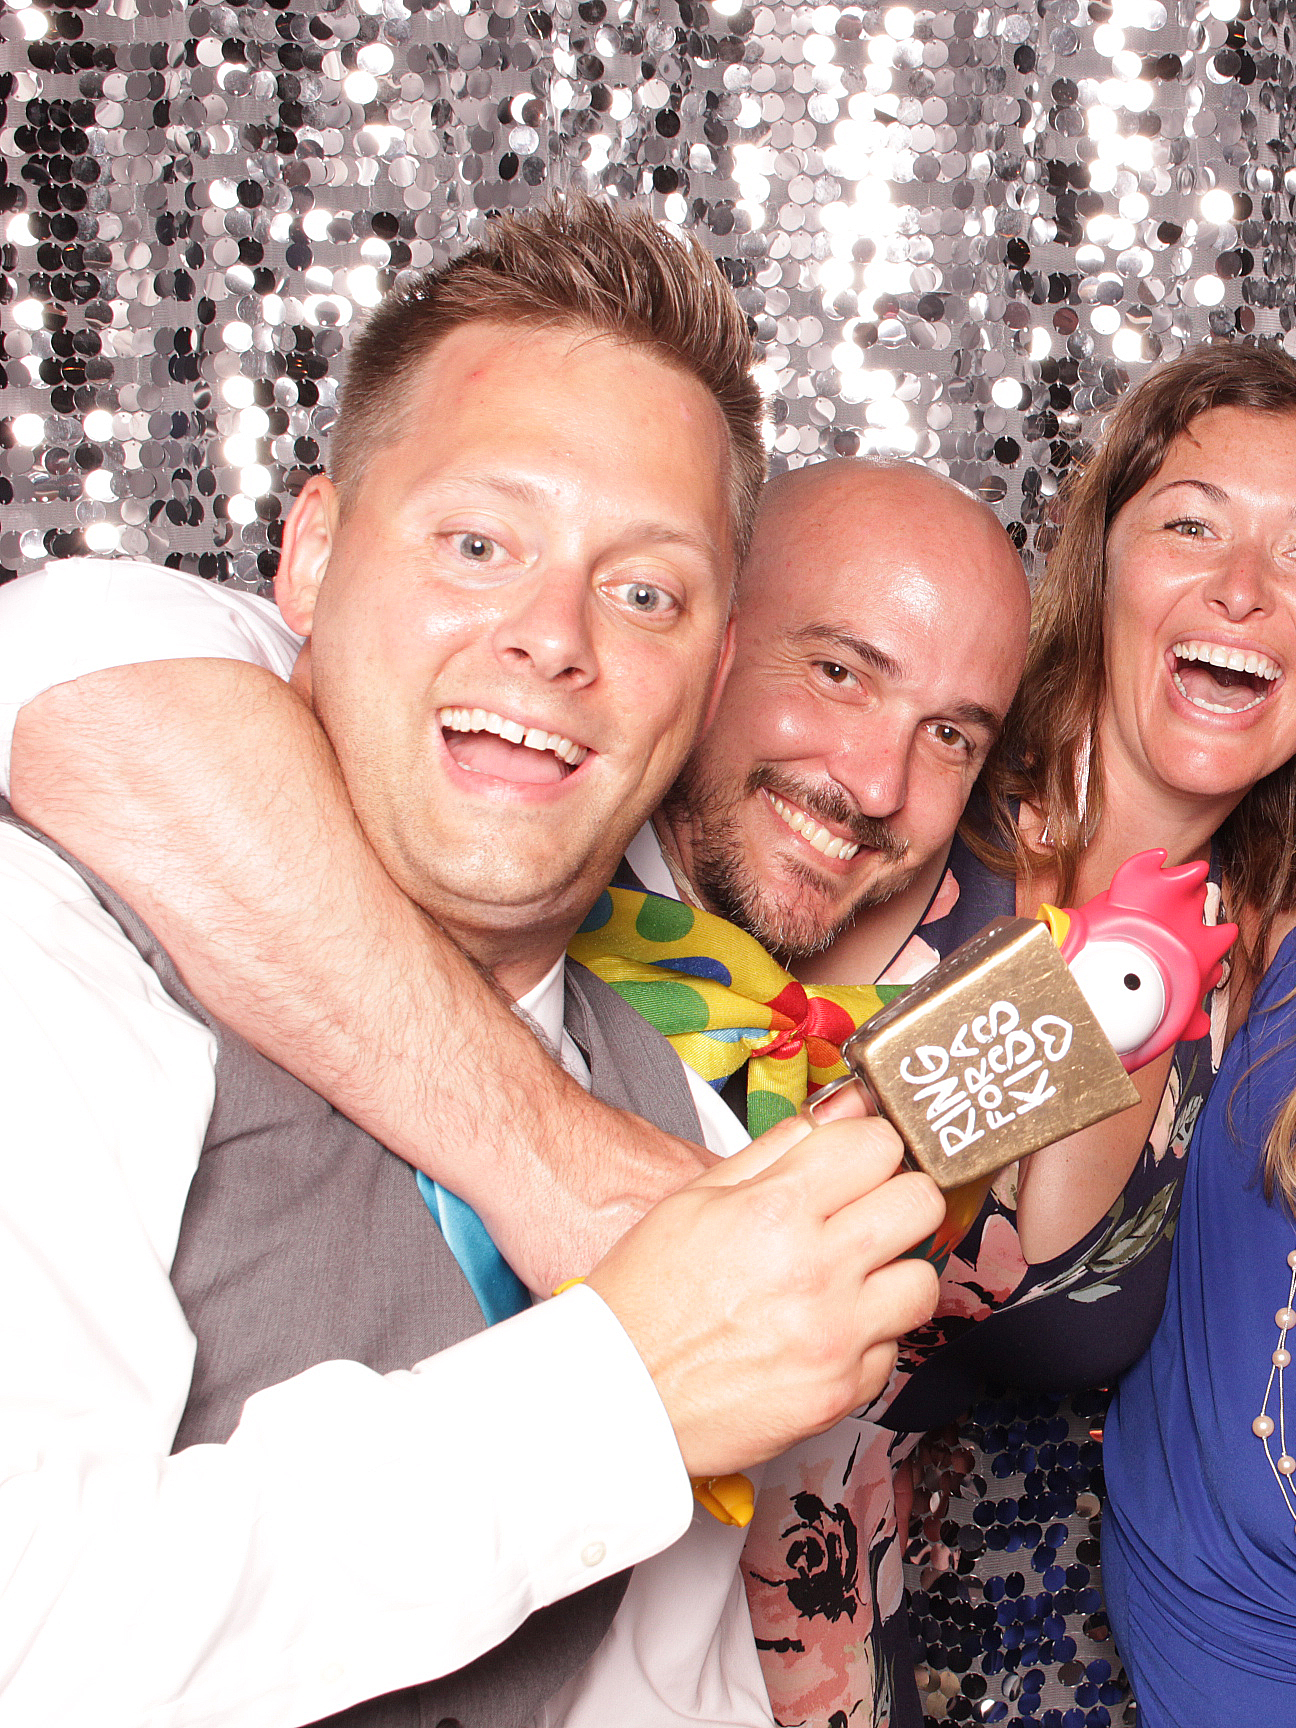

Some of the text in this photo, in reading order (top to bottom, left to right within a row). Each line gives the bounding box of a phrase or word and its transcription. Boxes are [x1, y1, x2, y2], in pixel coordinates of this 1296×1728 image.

[900, 1045, 985, 1157] RING
[950, 1023, 1016, 1130] FOR A
[971, 1000, 1057, 1115] KISS
